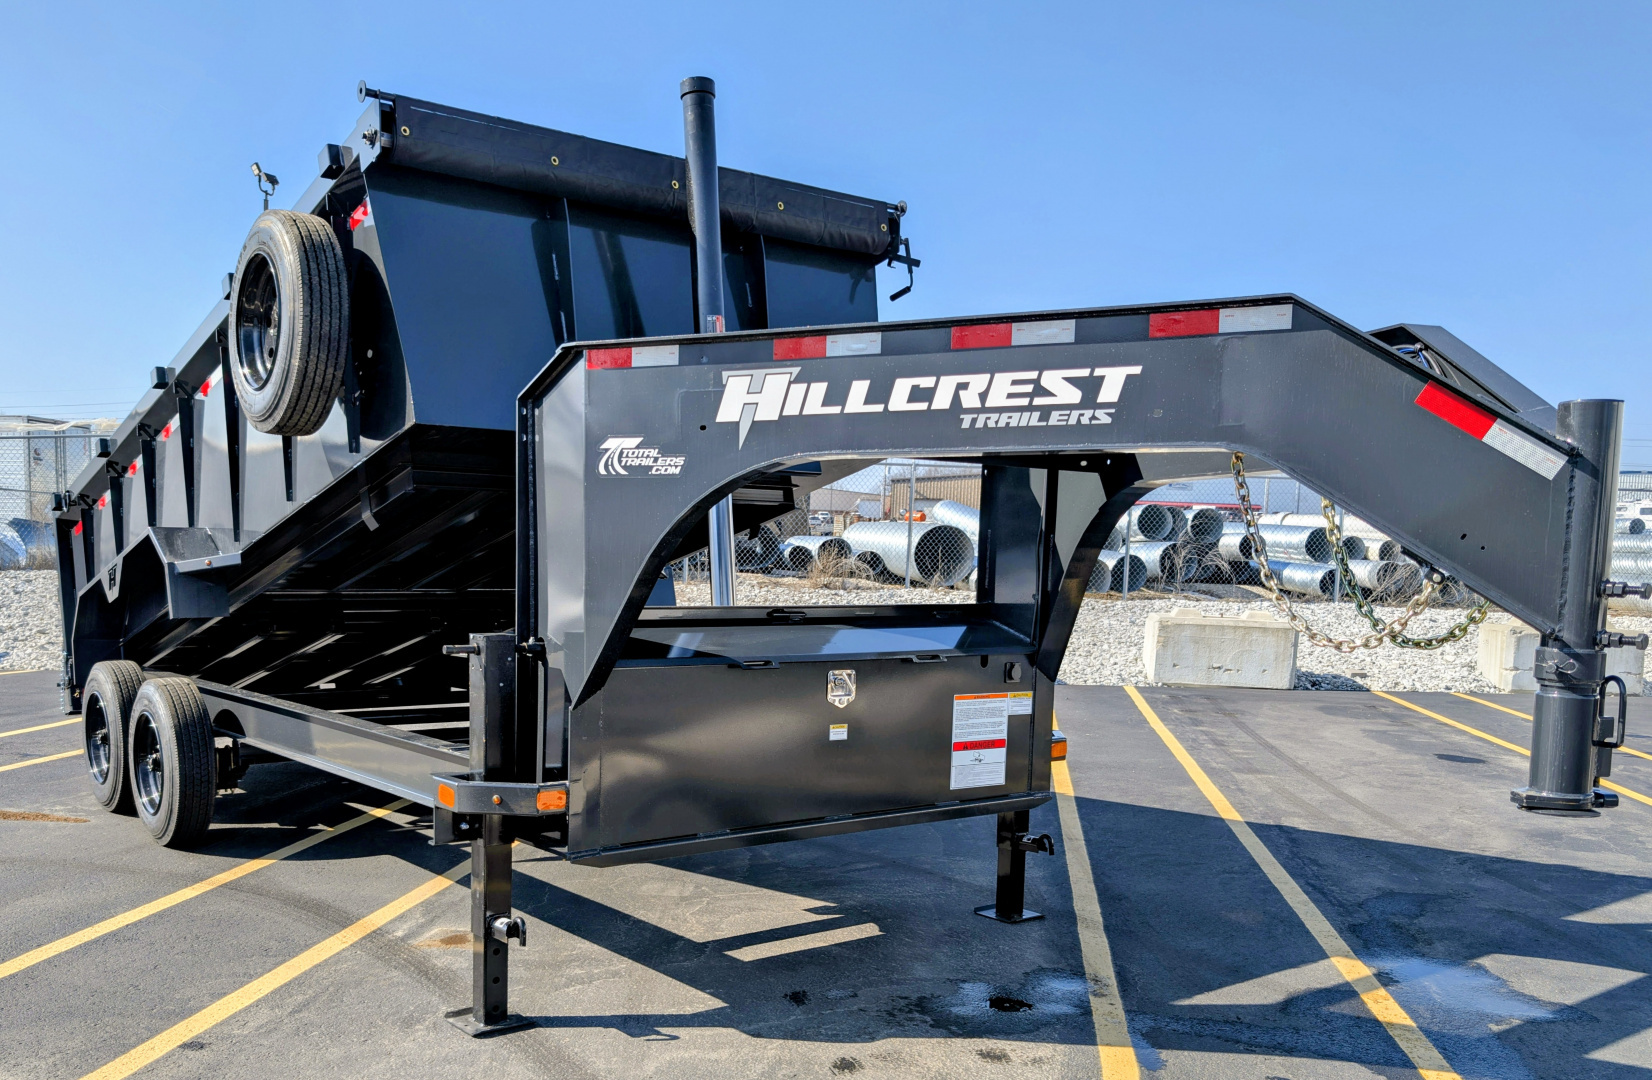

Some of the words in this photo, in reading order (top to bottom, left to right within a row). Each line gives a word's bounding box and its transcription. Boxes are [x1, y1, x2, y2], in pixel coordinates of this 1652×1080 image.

[715, 366, 1143, 424] HILLCREST
[958, 408, 1116, 430] TRAILERS
[622, 448, 662, 458] TOTAL
[620, 457, 686, 467] TRAILERS
[648, 466, 682, 475] .COM
[969, 741, 996, 749] DANGER
